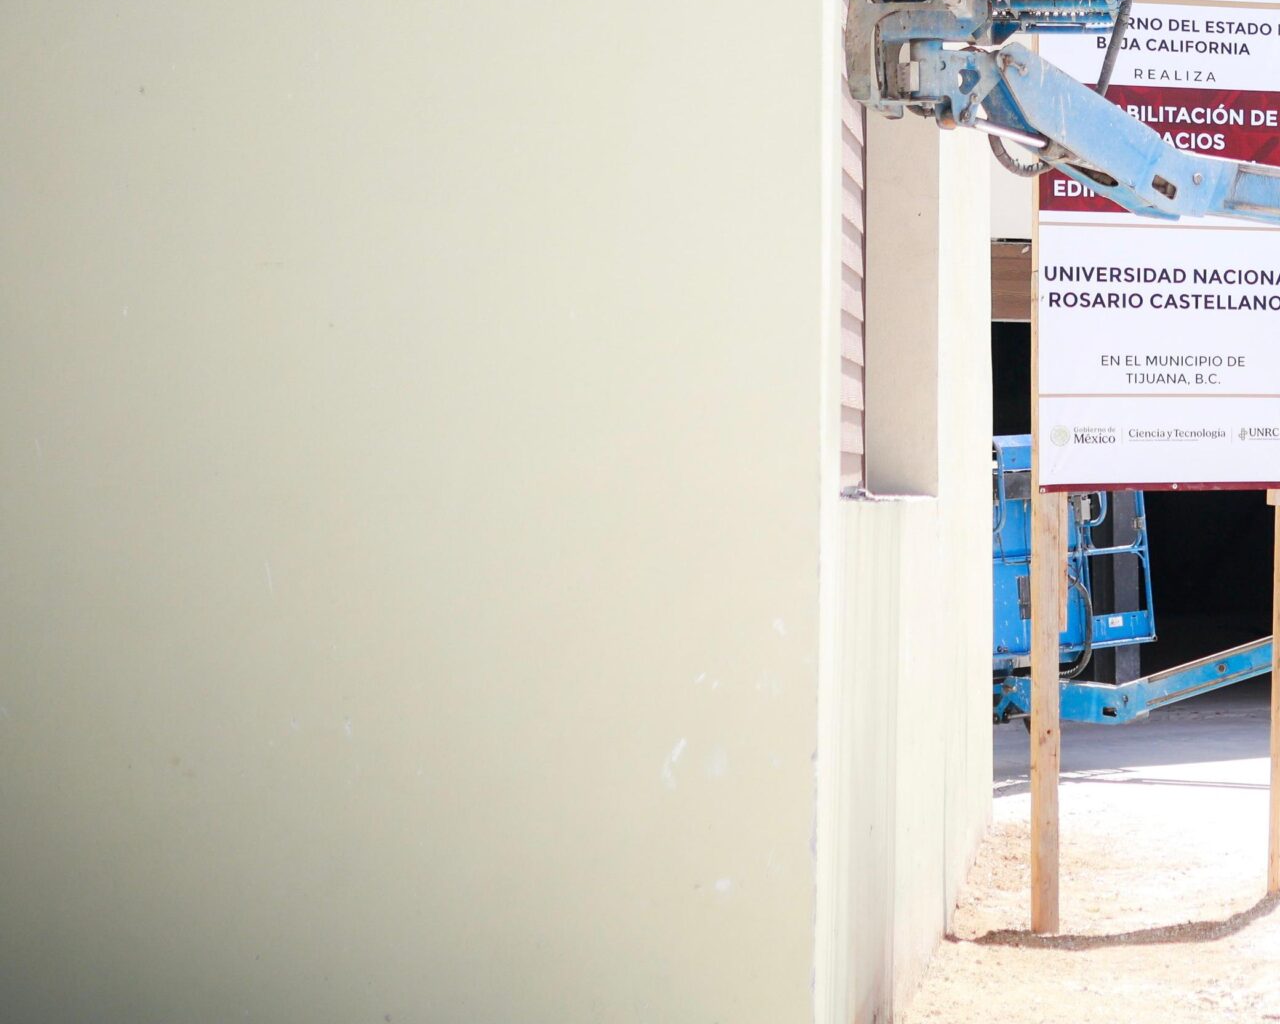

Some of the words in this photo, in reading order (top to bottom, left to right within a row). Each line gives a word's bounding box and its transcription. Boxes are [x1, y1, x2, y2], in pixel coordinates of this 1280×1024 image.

[1168, 19, 1200, 33] DEL
[1205, 21, 1272, 36] ESTADO
[1097, 37, 1141, 51] BJA
[1146, 39, 1250, 55] CALIFORNIA
[1134, 68, 1216, 82] REALIZA
[1251, 110, 1278, 126] DE
[1044, 266, 1187, 283] UNIVERSIDAD
[1048, 292, 1144, 309] ROSARIO
[1101, 355, 1120, 366] EN
[1125, 355, 1141, 367] EL
[1145, 355, 1223, 367] MUNICIPIO
[1228, 356, 1246, 367] DE
[1126, 372, 1191, 386] TIJUANA,
[1195, 372, 1221, 385] B.C.
[1073, 433, 1116, 444] México
[1128, 428, 1165, 438] Ciencia
[1167, 431, 1173, 440] y
[1173, 428, 1226, 439] Tecnología
[1249, 427, 1279, 437] UNRC
